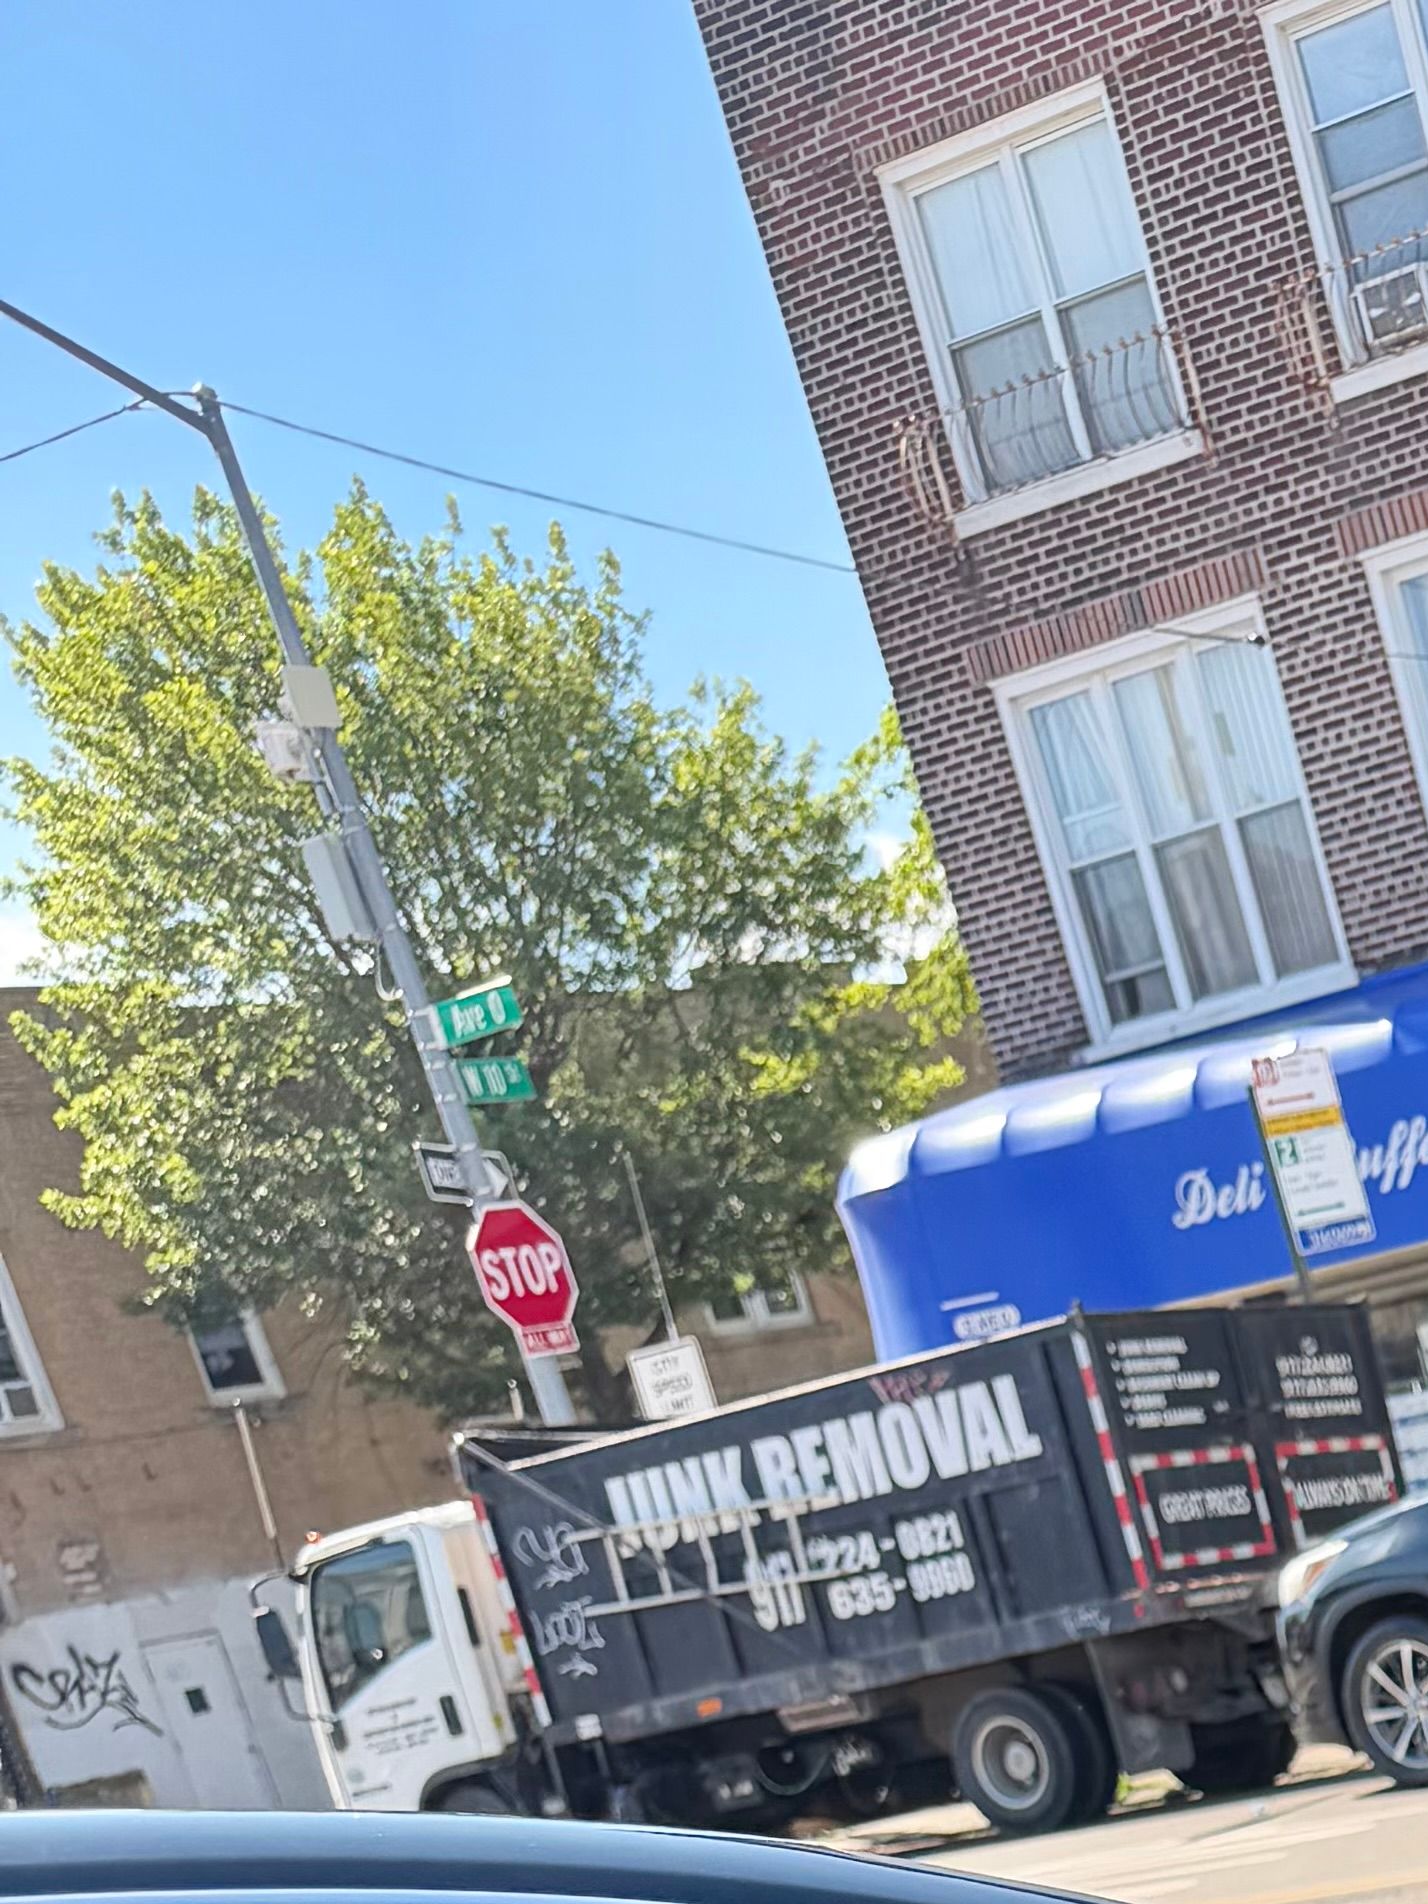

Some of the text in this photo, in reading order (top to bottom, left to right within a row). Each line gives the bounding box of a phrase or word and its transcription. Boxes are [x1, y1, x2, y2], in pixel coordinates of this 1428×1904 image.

[1172, 1161, 1267, 1231] Deli
[480, 1241, 563, 1301] STOP
[603, 1444, 761, 1558] JUNK
[752, 1373, 1044, 1522] REMOVAL
